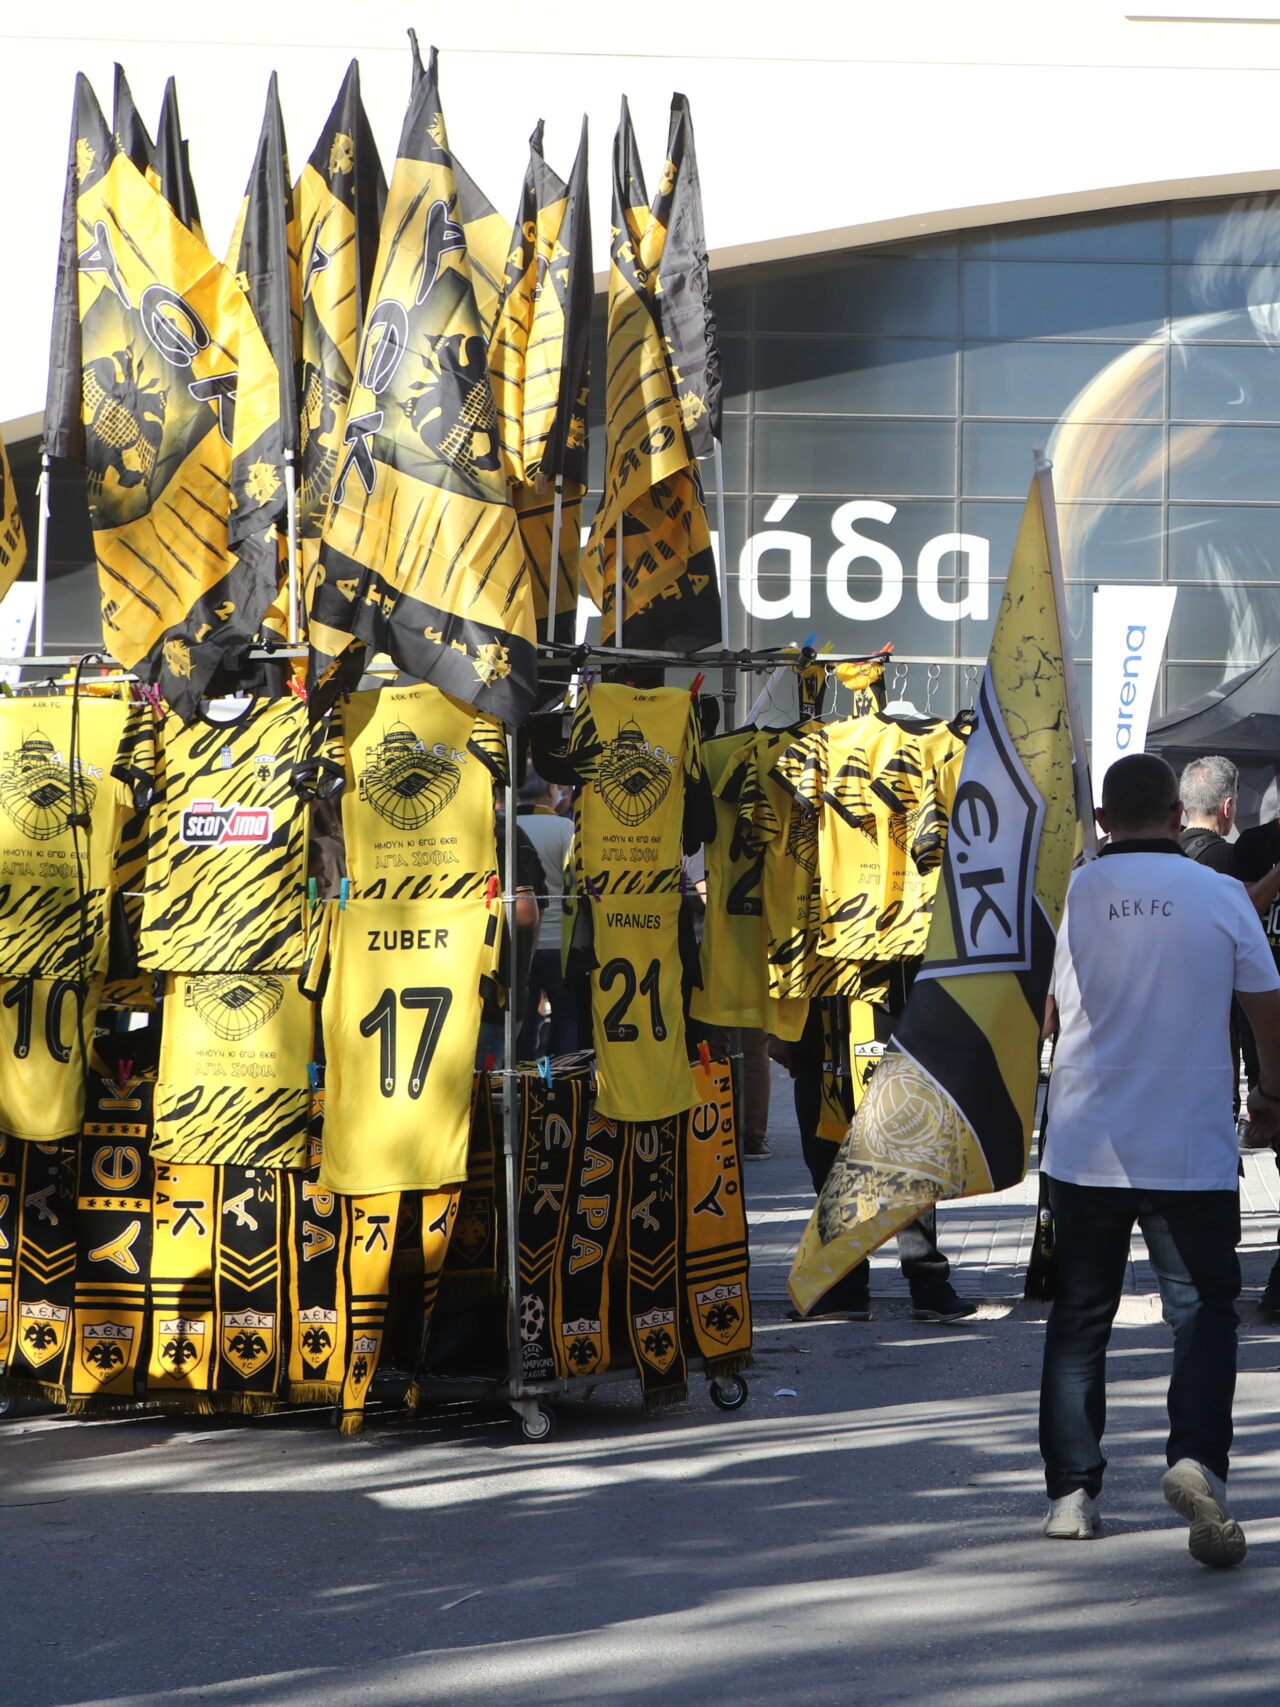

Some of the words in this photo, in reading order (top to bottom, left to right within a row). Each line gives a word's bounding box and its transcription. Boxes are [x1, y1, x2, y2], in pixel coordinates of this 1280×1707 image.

[710, 494, 991, 622] άδα
[1116, 625, 1147, 751] arena
[367, 929, 449, 951] ZUBER
[606, 912, 662, 930] VRANJES
[1109, 898, 1144, 921] AEK
[1150, 898, 1174, 918] FC
[2, 976, 90, 1064] 10
[600, 957, 668, 1043] 21
[359, 986, 453, 1101] 17
[719, 1058, 739, 1196] ORIGIN
[521, 1358, 554, 1368] AMPIONS
[521, 1369, 547, 1379] EAGUE
